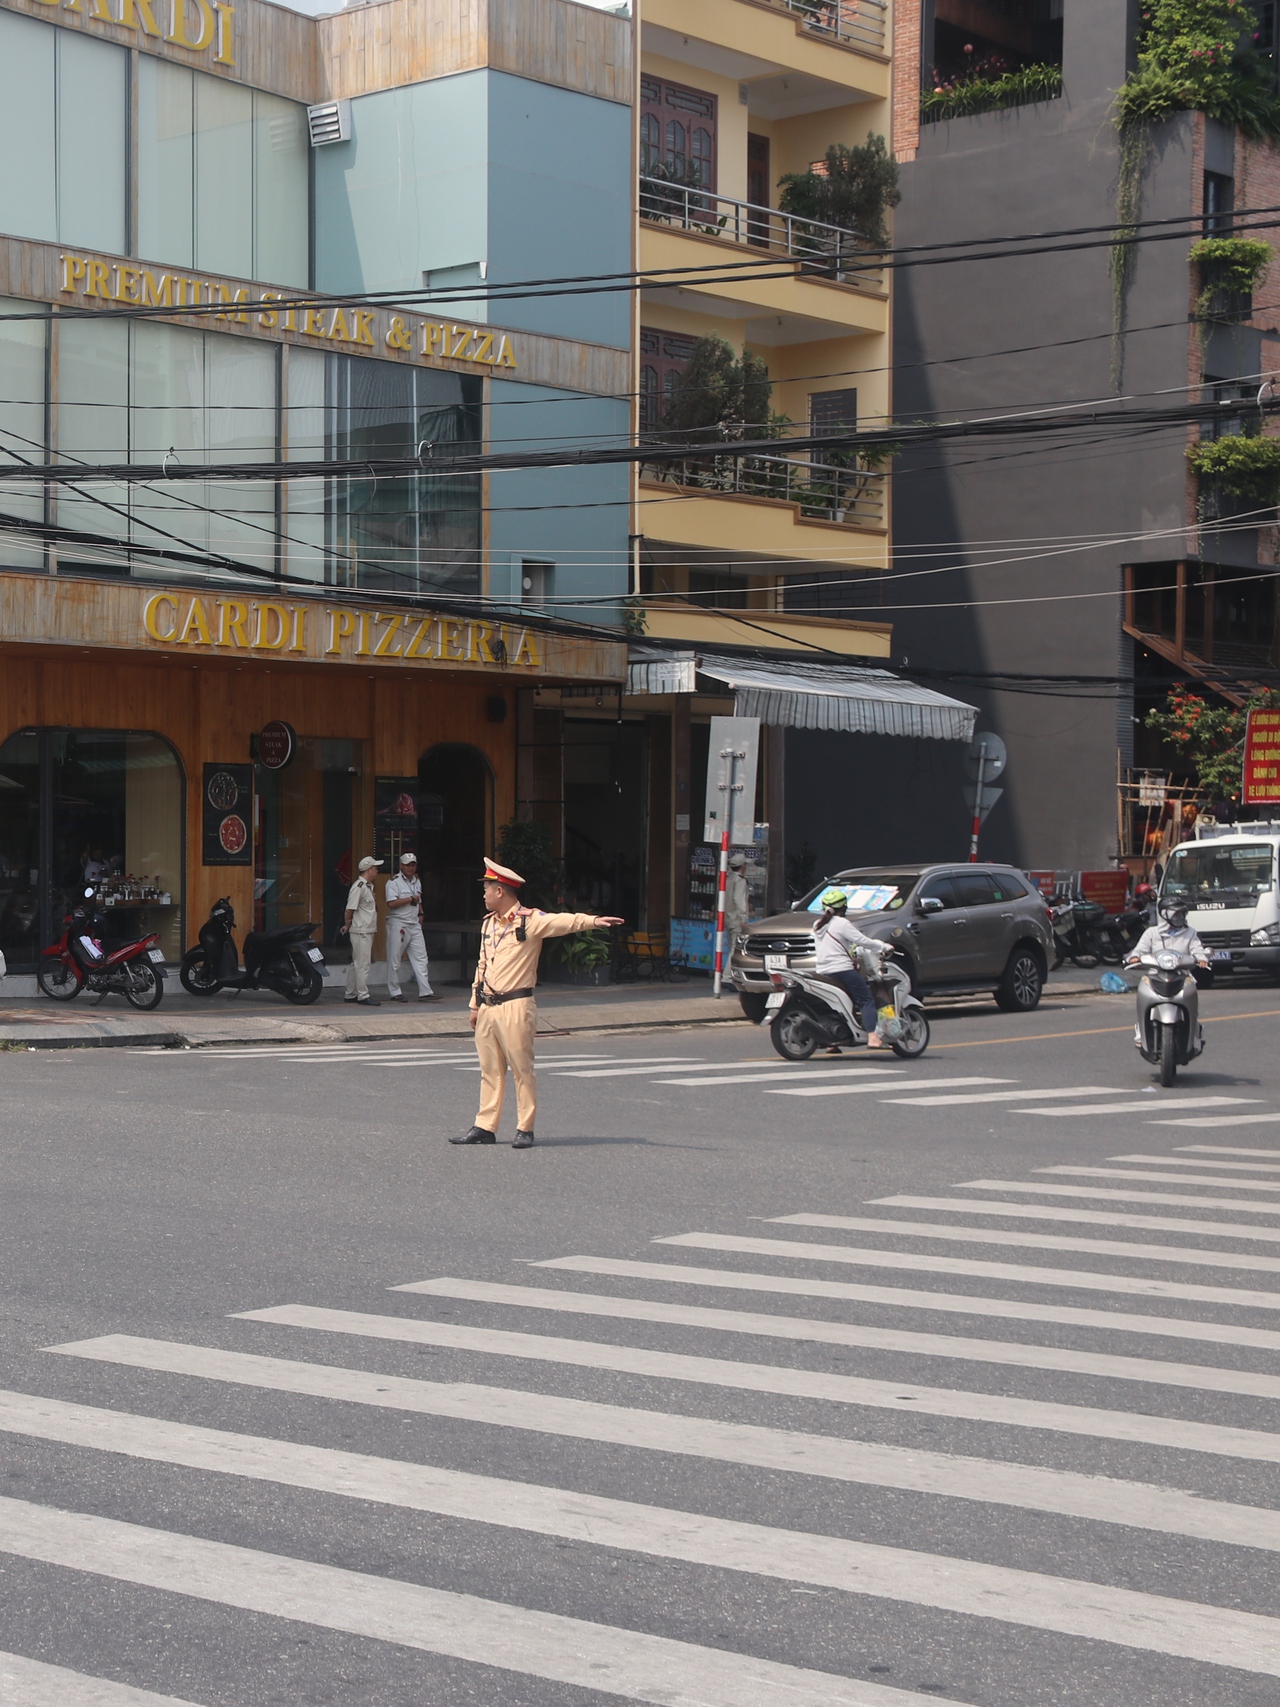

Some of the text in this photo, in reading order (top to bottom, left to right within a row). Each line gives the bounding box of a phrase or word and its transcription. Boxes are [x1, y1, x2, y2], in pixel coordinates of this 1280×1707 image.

[60, 254, 518, 368] PREMIUM STEAK & PIZZA
[143, 594, 543, 667] CARDI PIZZERIA
[695, 847, 713, 857] COLD
[691, 856, 715, 866] DRINKS
[1197, 902, 1225, 910] ISUZU
